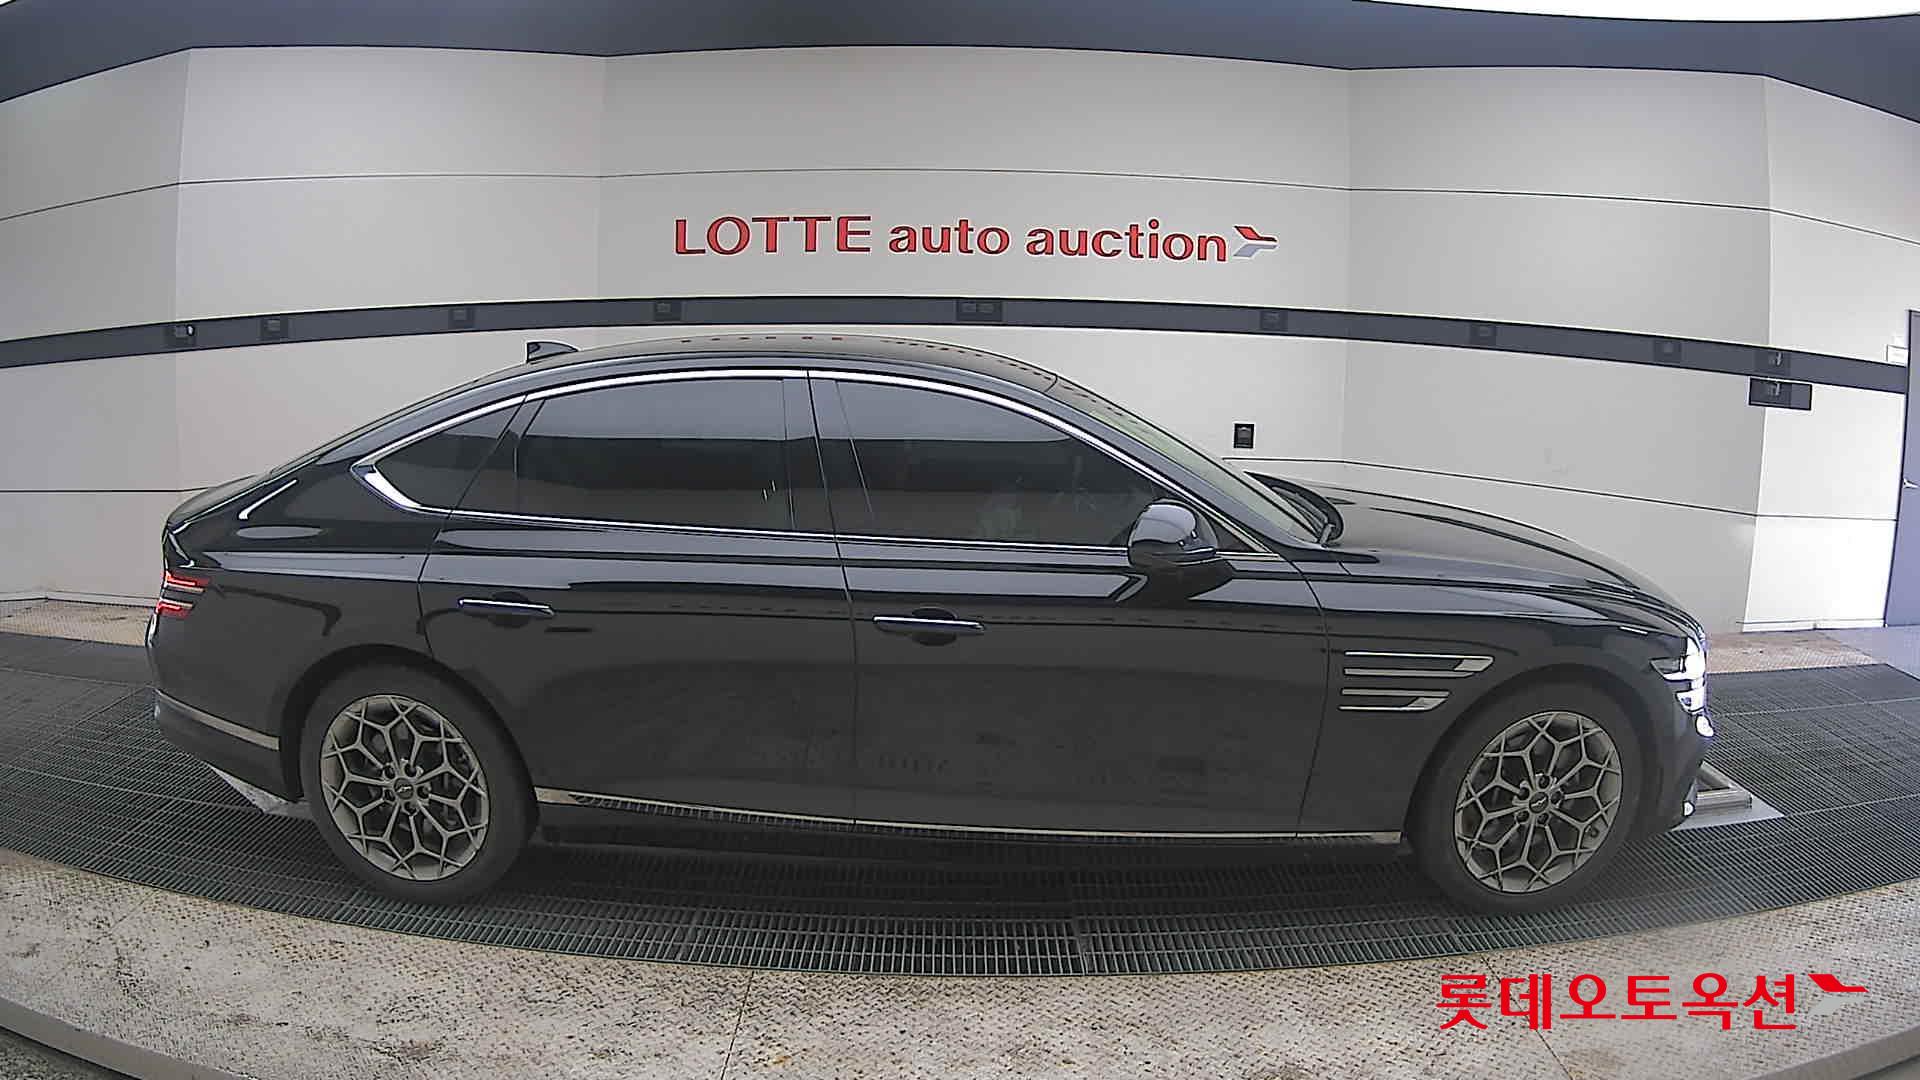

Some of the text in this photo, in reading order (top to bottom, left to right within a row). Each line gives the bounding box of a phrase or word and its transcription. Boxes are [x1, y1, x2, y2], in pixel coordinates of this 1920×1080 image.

[674, 215, 1227, 262] LOTTE auto auction
